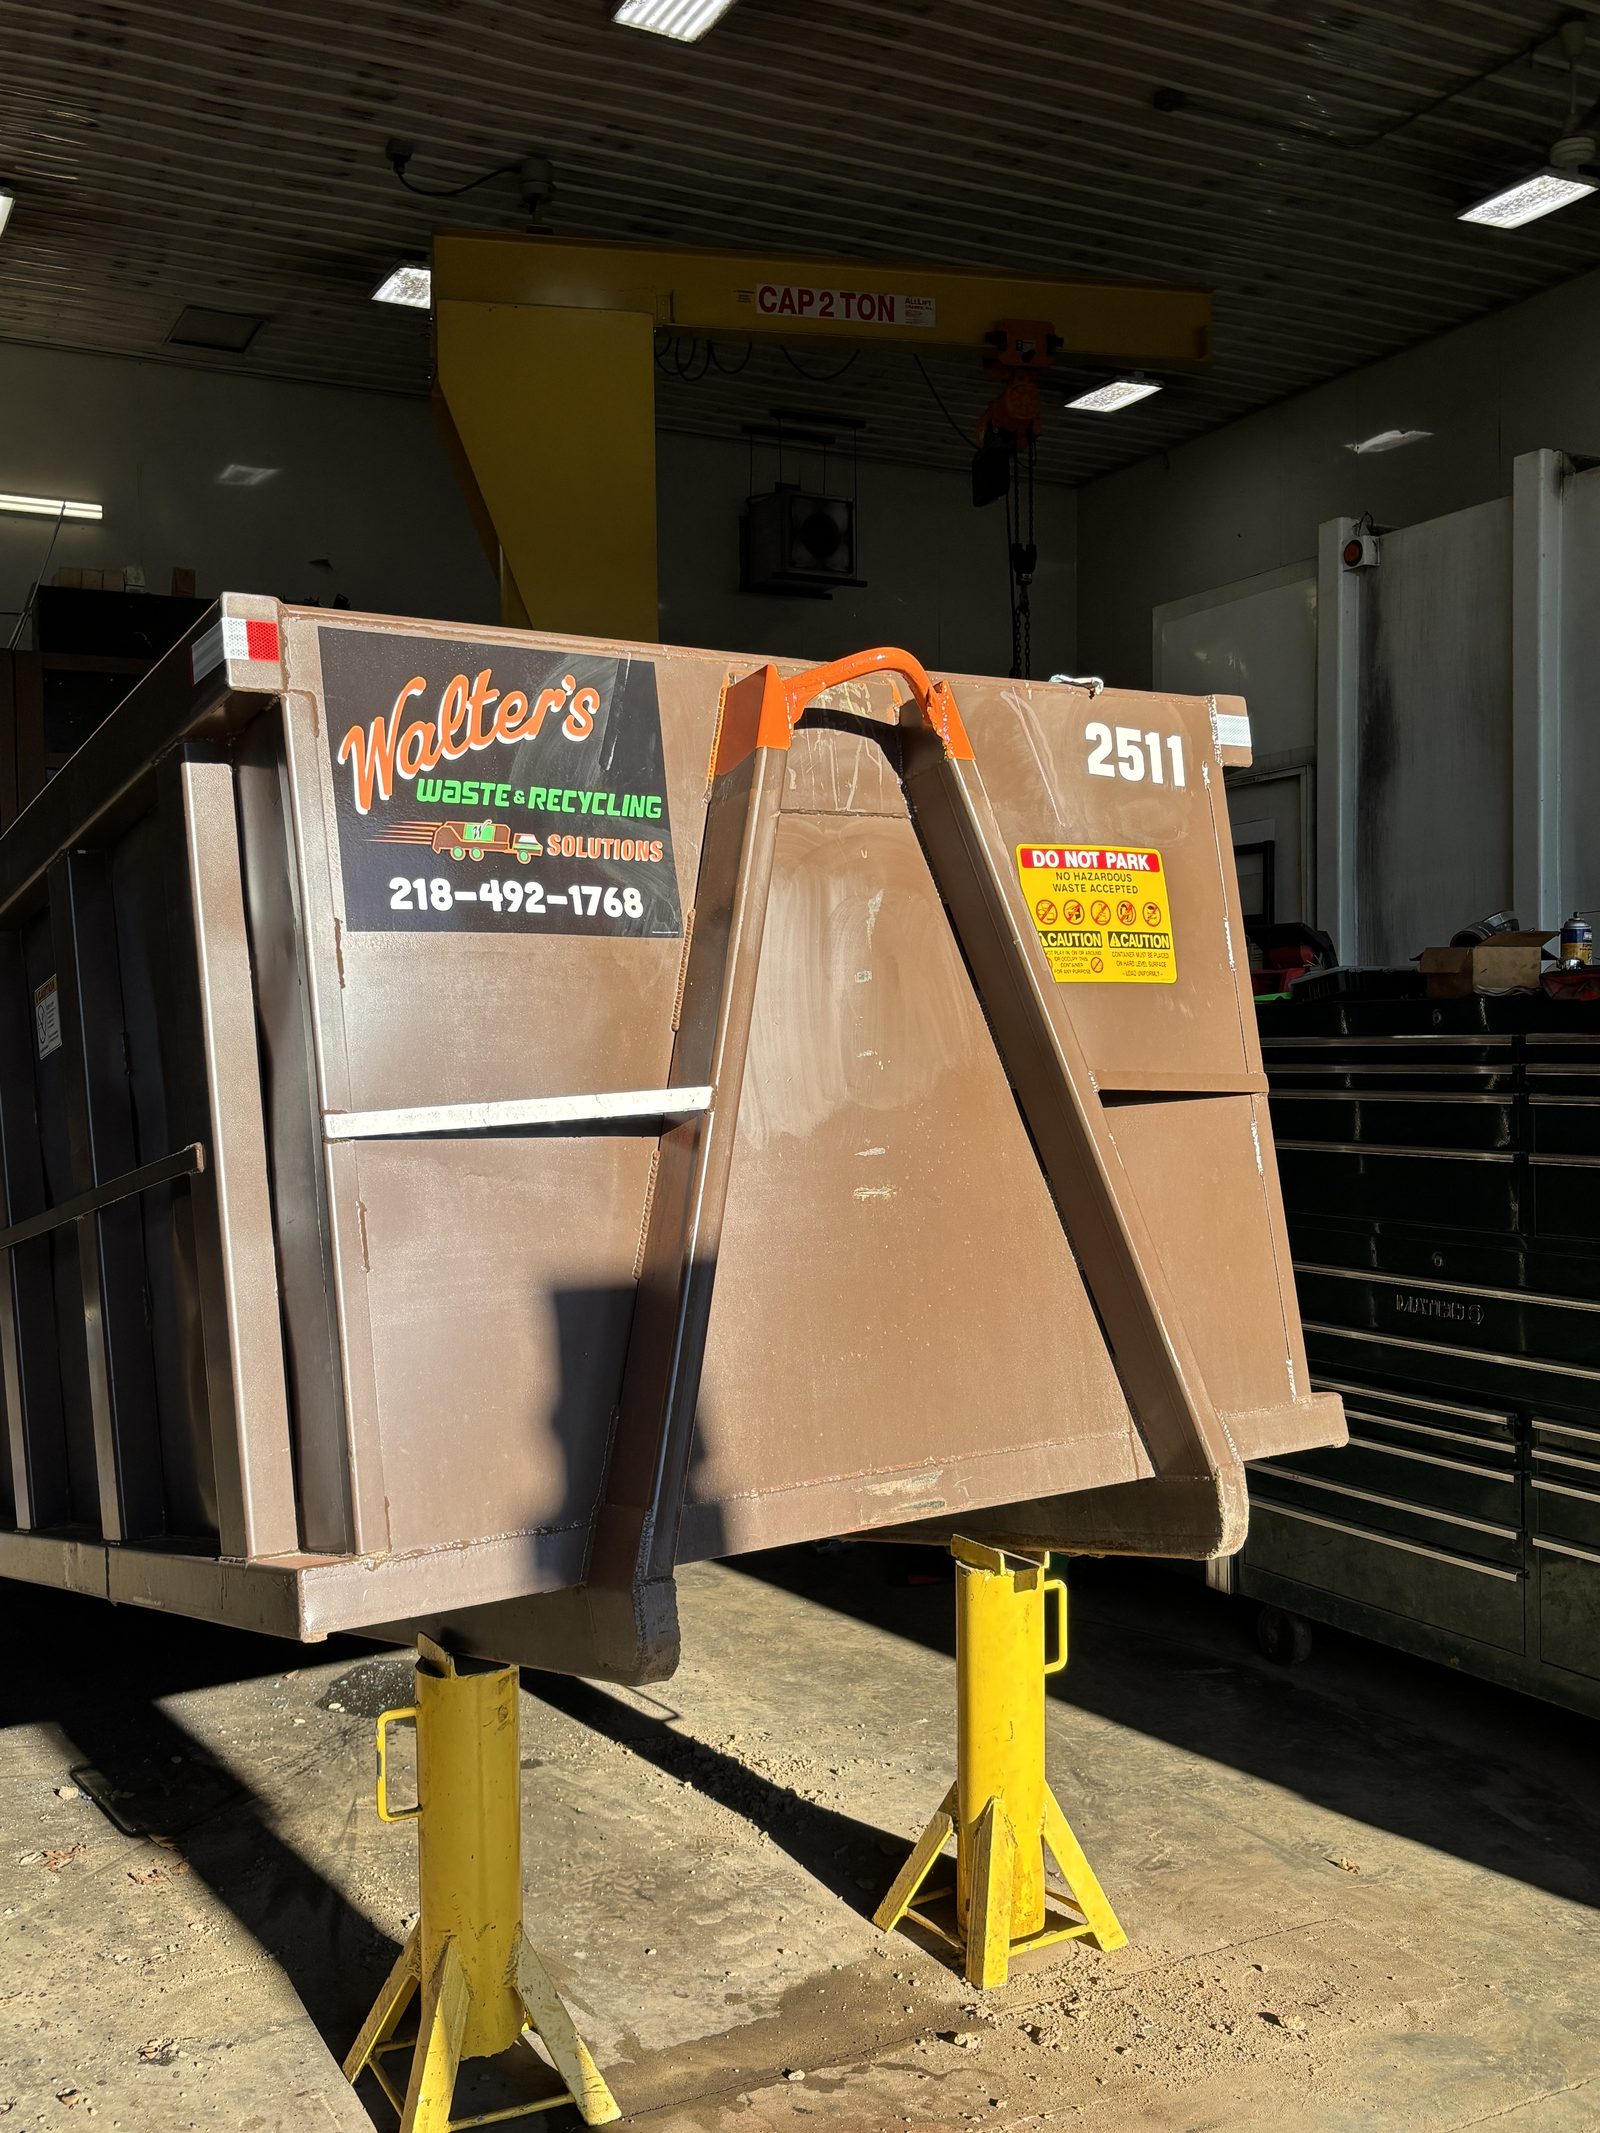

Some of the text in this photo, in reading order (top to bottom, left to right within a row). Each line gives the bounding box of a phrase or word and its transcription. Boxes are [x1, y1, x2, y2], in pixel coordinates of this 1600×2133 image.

[758, 286, 814, 315] CAP
[819, 291, 835, 318] 2
[839, 292, 895, 323] TON
[337, 668, 600, 815] Walter's
[1085, 722, 1186, 787] 2511
[416, 778, 663, 819] WASTE & RECYCLING
[547, 833, 664, 863] SOLUTIONS
[1031, 850, 1151, 871] DO NOT PARK
[1053, 883, 1139, 894] WASTE ACCEPTED
[1056, 872, 1133, 882] NO HAZARDOUS
[388, 877, 645, 919] 218-492-1768
[1047, 932, 1102, 947] CAUTION
[1120, 934, 1170, 949] CAUTION
